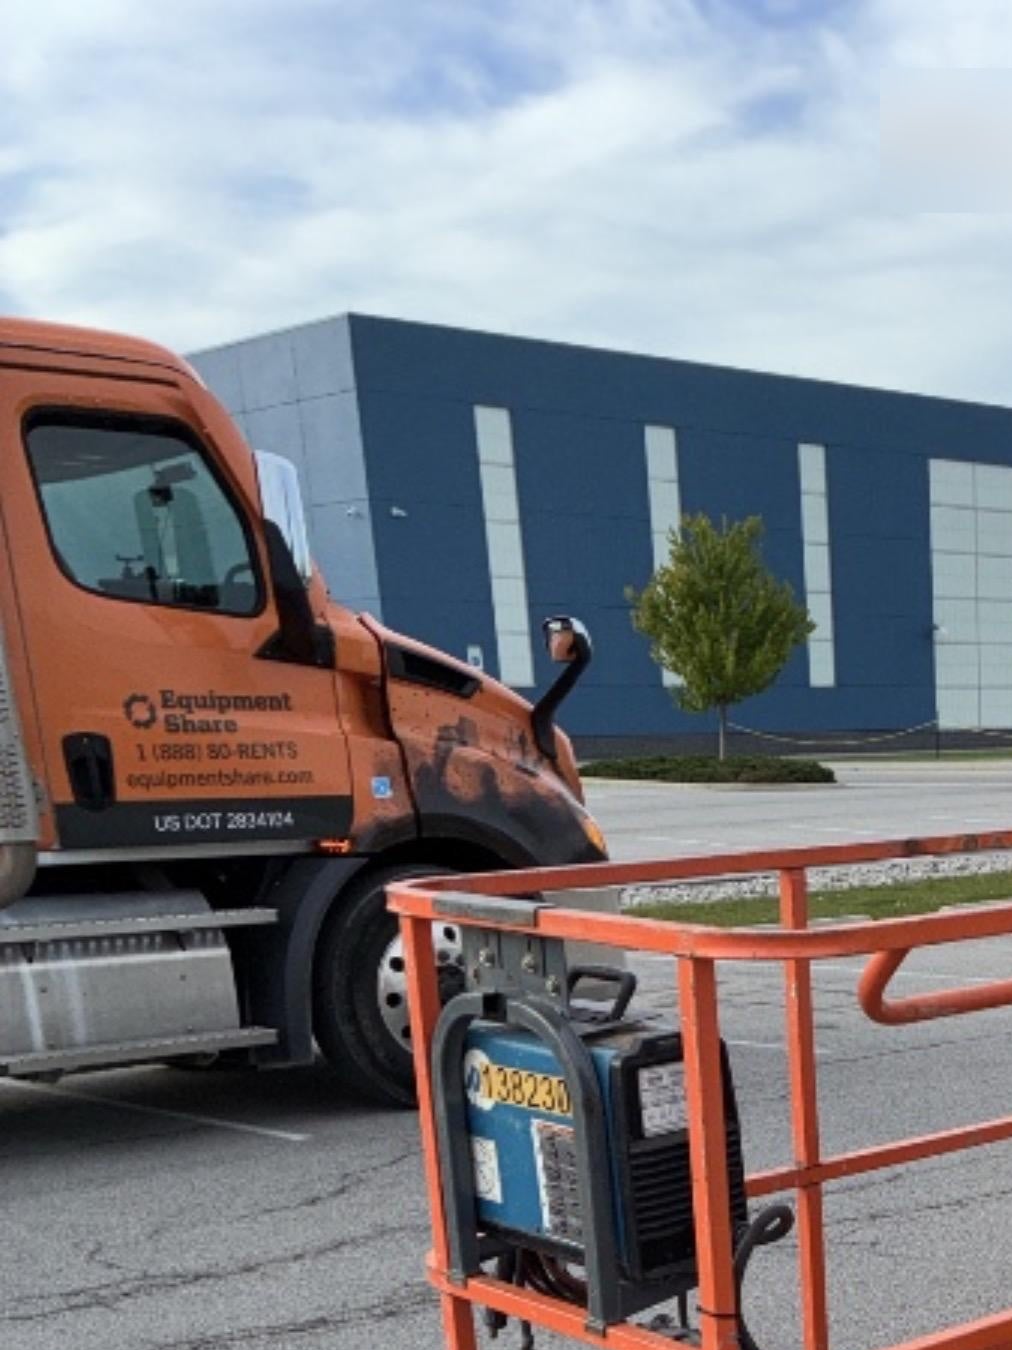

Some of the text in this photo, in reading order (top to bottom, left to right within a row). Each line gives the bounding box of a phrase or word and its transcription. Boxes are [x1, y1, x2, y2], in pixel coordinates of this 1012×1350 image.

[159, 689, 292, 713] Equipment
[164, 713, 238, 734] Share
[136, 743, 147, 762] 1
[152, 742, 201, 763] (888)
[127, 767, 314, 790] equipmentshare.com
[154, 814, 181, 832] US
[184, 812, 223, 830] DOT
[482, 1065, 572, 1114] 138230
